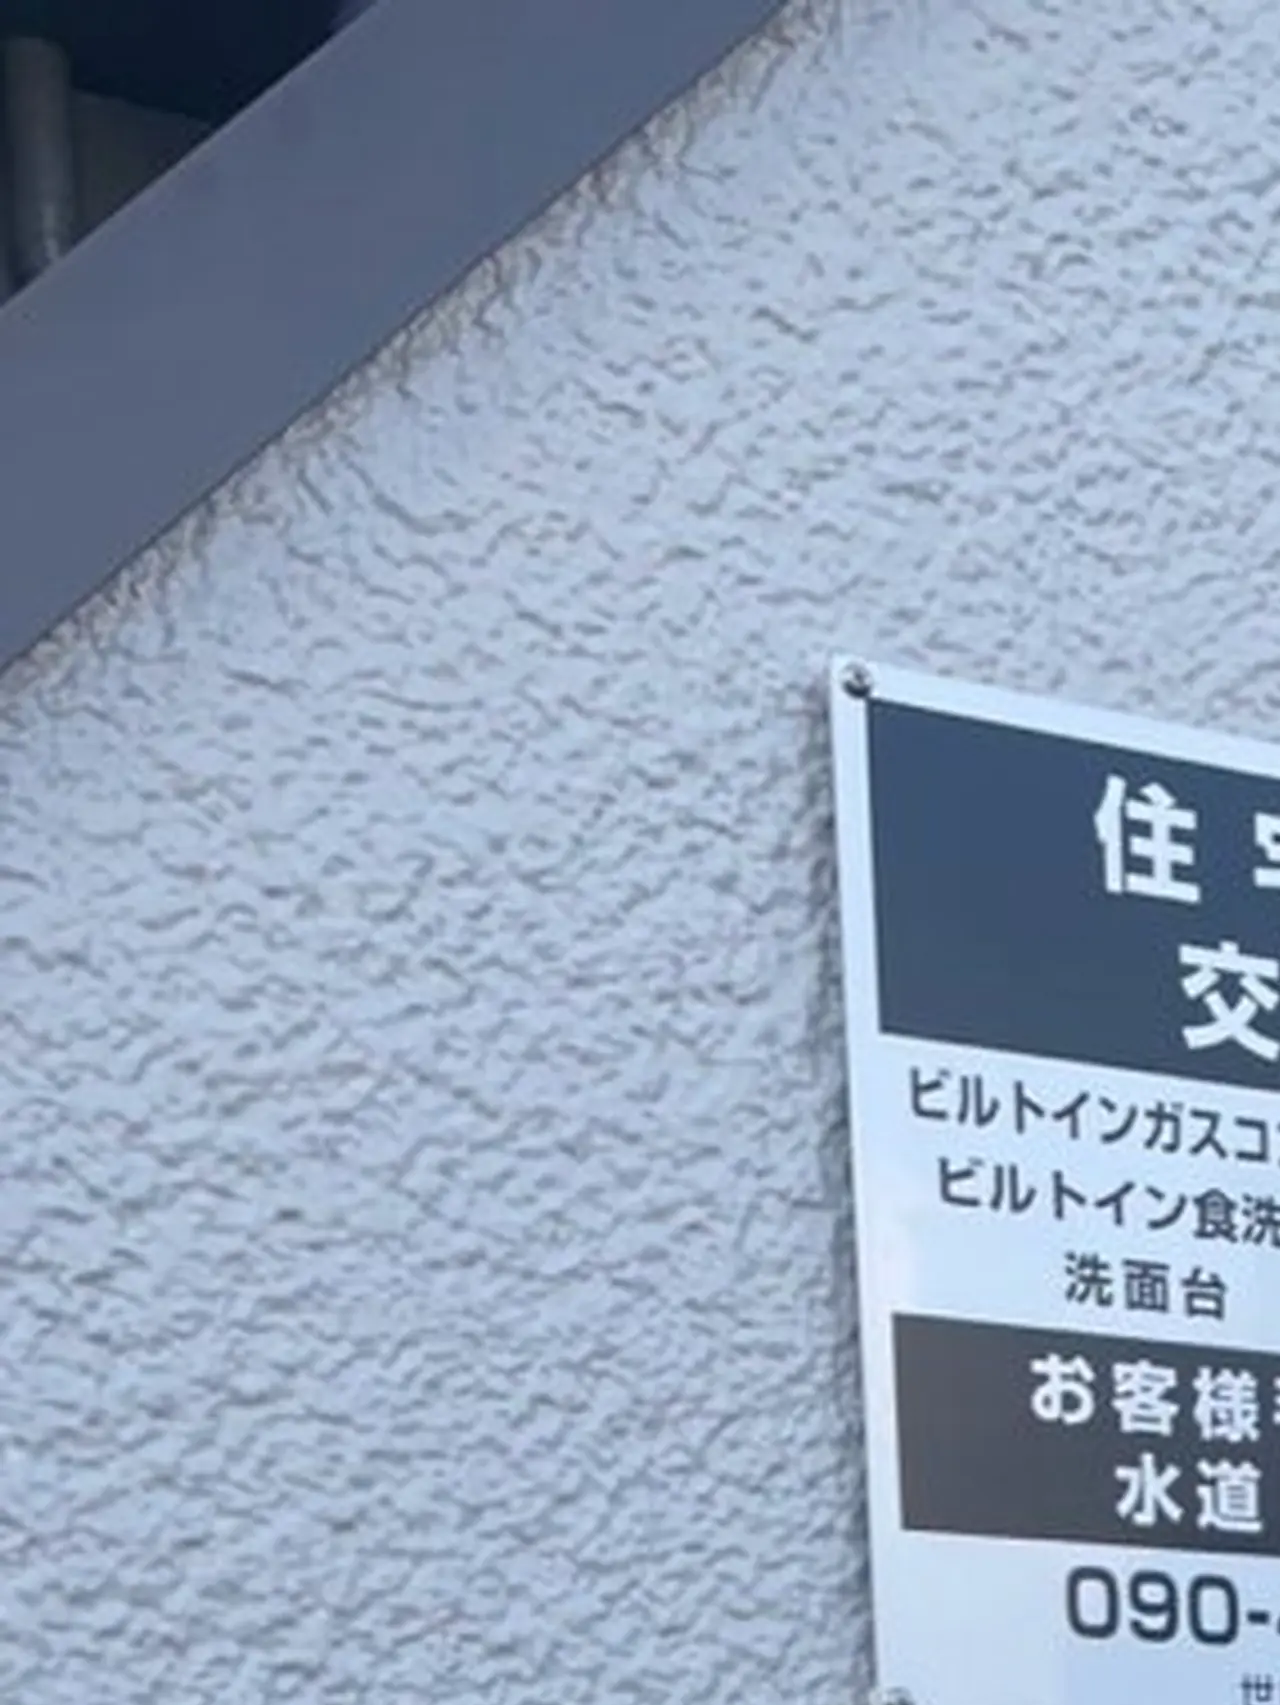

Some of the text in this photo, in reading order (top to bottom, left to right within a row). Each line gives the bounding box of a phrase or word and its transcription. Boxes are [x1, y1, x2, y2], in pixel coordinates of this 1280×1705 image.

[1064, 1251, 1228, 1321] 洗面台
[1116, 1454, 1263, 1534] 水道
